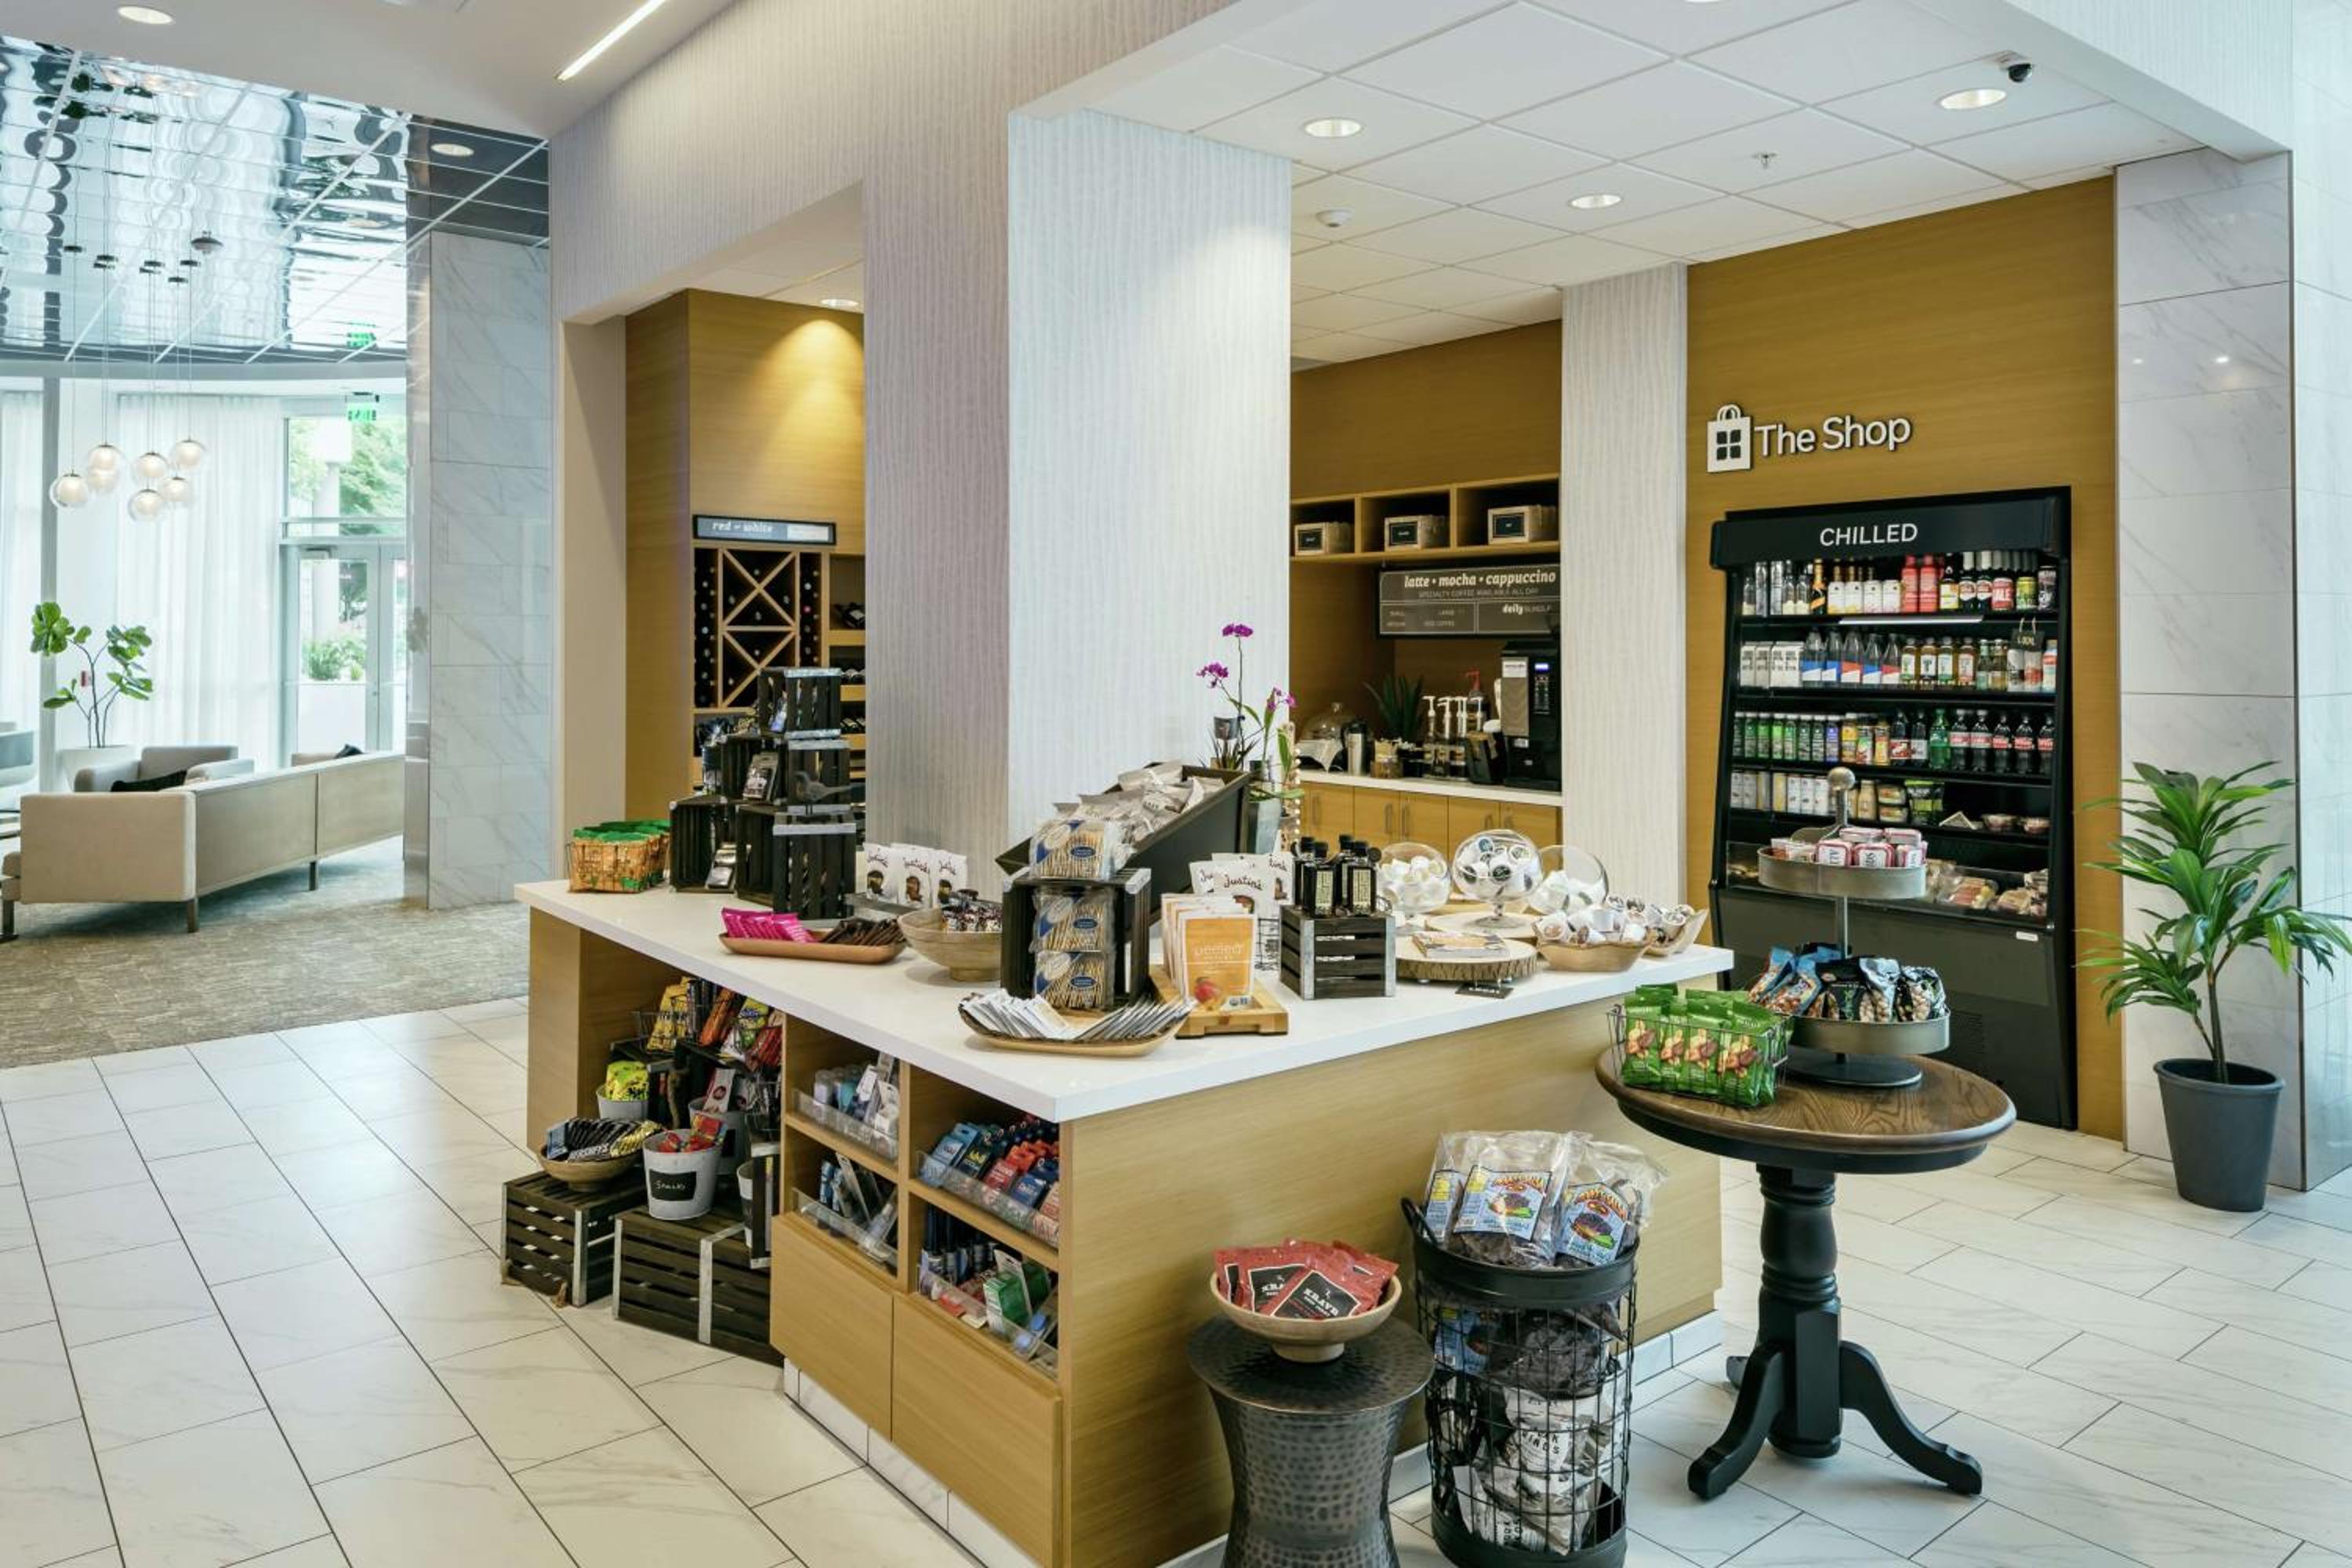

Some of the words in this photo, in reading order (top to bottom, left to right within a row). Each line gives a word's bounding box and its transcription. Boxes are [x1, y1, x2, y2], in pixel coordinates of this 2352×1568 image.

[1755, 423, 1816, 457] The
[1823, 415, 1911, 451] Shop
[1820, 523, 1918, 546] CHILLED
[1404, 575, 1430, 588] latte
[1439, 573, 1476, 586] mocha
[1486, 569, 1555, 588] cappuccino
